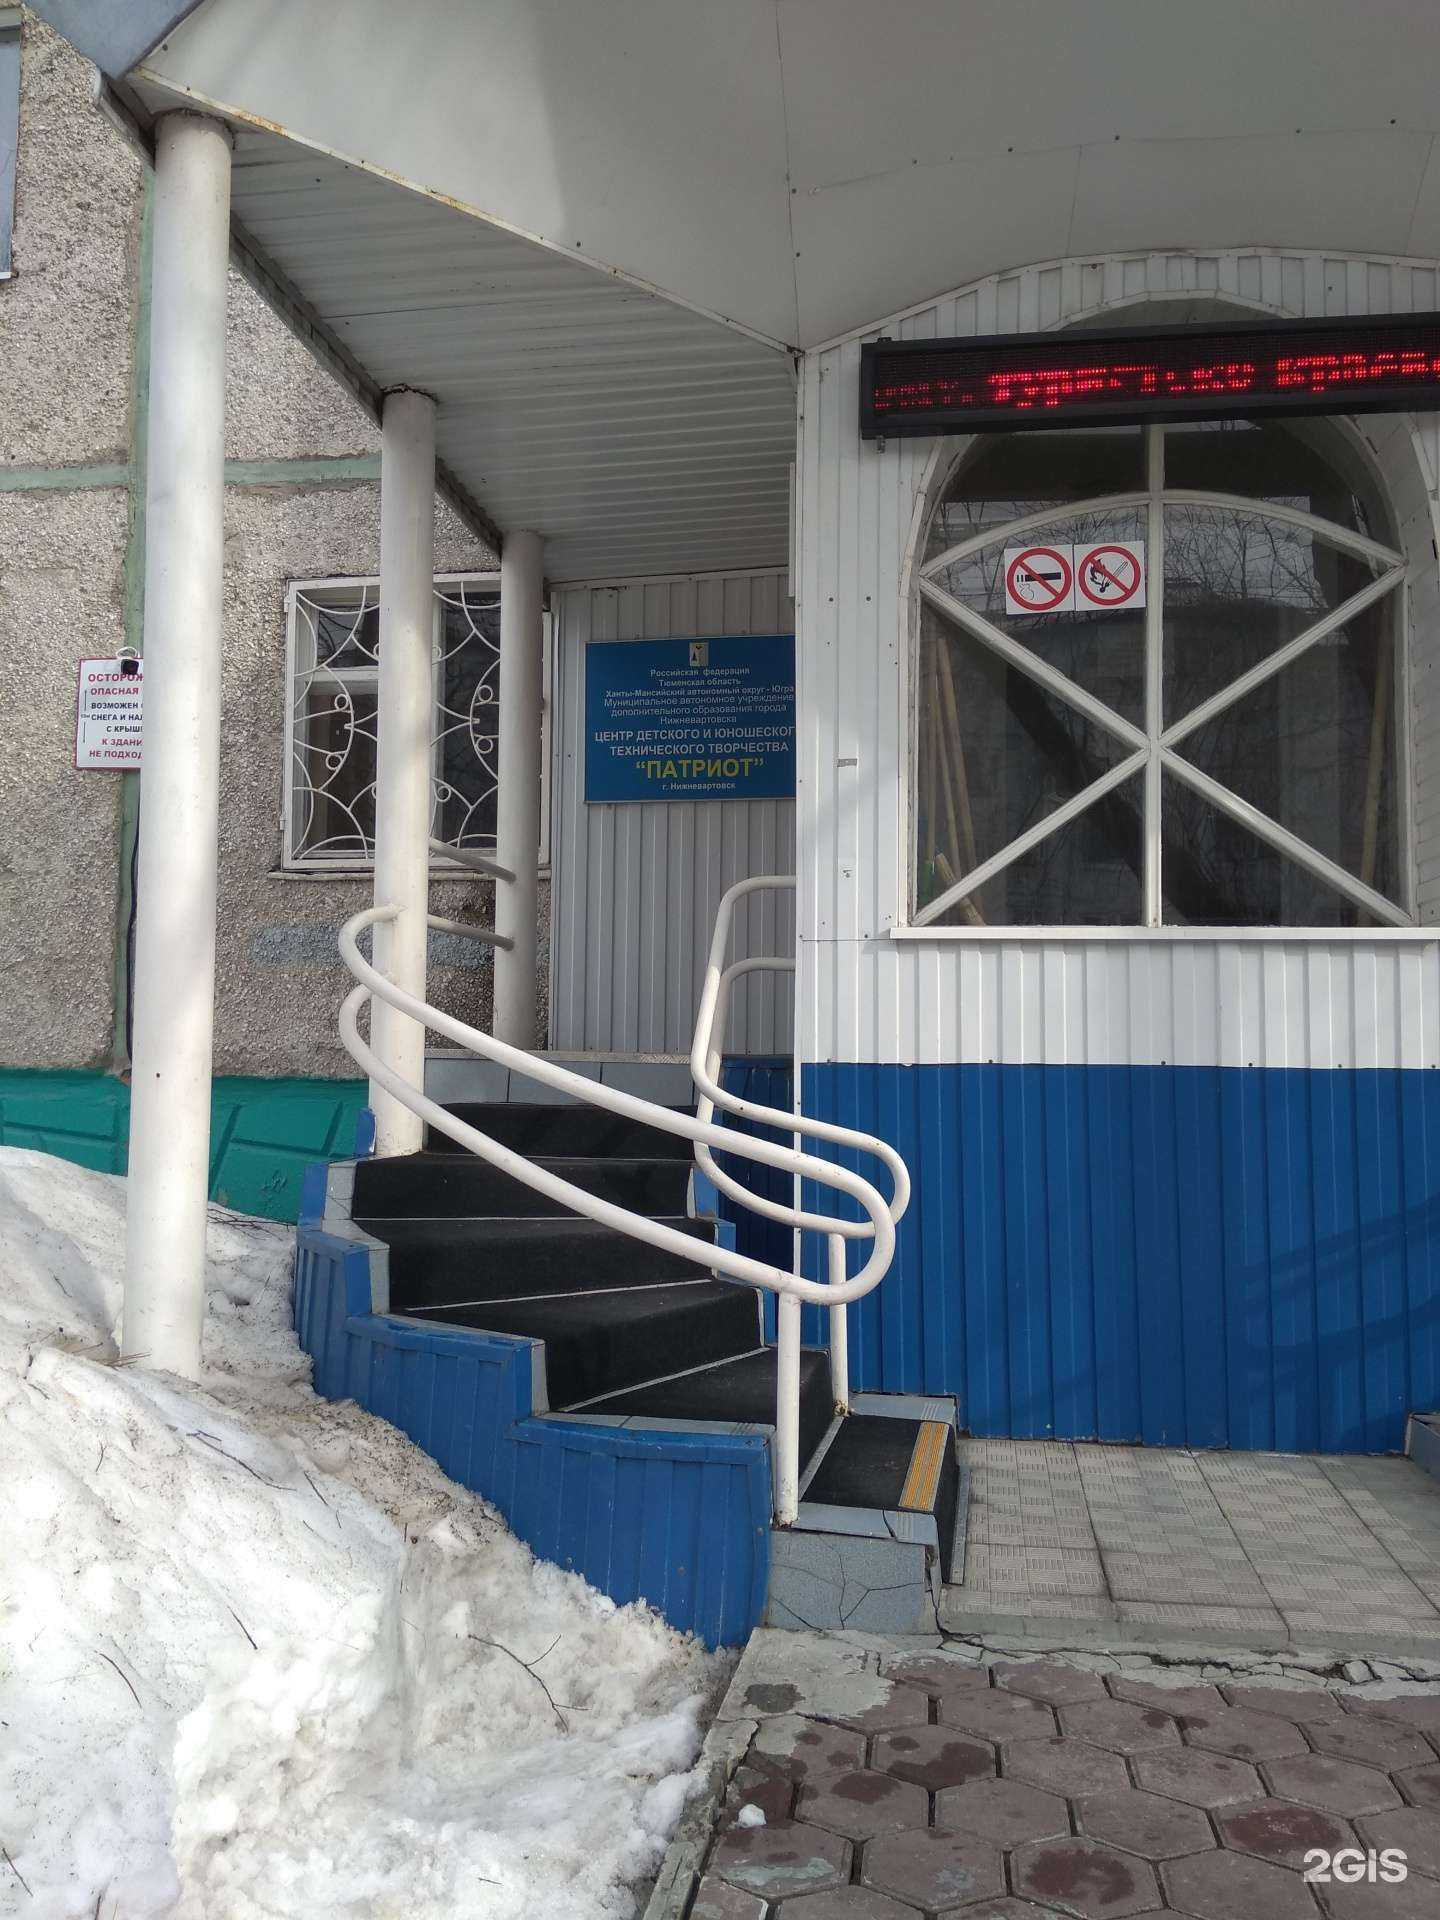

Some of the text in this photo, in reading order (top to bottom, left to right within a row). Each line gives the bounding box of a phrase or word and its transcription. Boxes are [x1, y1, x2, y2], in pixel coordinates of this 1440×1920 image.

[650, 669, 699, 677] Российская
[706, 678, 742, 686] область
[90, 688, 139, 696] ОПАСНАЯ
[687, 687, 740, 696] автономный
[604, 693, 794, 708] Муниципальное автономное учреждение
[91, 702, 139, 710] ВОЗМОЖЕН
[610, 704, 787, 718] дополнительного образования города
[91, 713, 118, 721] СНЕГА
[660, 716, 737, 725] Нижневартовска
[595, 730, 634, 743] ЦЕНТР
[636, 728, 700, 742] ДЕТСКОГО
[703, 728, 712, 738] И
[609, 742, 790, 756] ТЕХНИЧЕСКОГО ТВОРЧЕСТВА
[89, 750, 102, 758] НЕ
[670, 782, 737, 791] Нижневартовск
